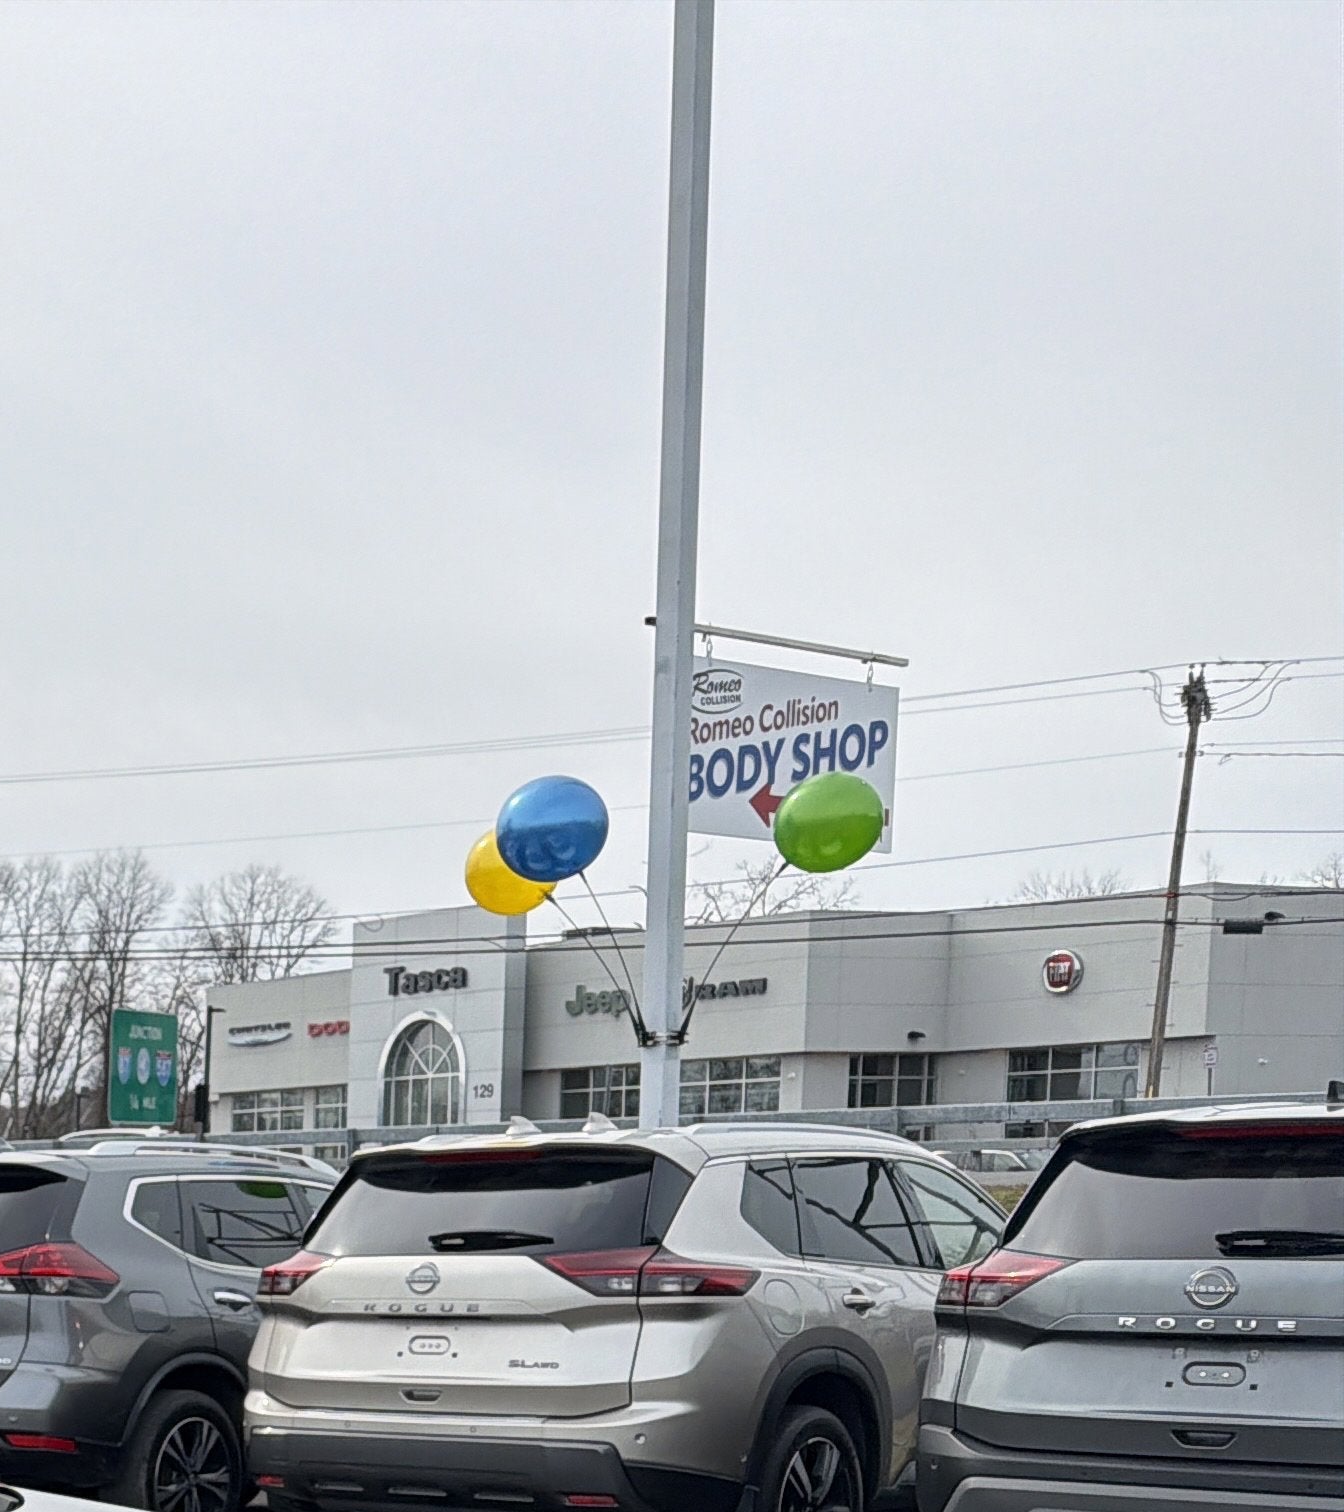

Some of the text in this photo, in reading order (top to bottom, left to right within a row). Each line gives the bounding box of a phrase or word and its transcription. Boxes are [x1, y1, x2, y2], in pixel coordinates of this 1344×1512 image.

[692, 671, 742, 698] Romeo
[700, 694, 742, 706] COLLISION
[759, 696, 839, 733] Collision
[791, 720, 889, 784] SHOP
[383, 966, 468, 996] Tasca
[694, 977, 768, 1001] RAM
[565, 984, 631, 1018] Jeep
[472, 1083, 495, 1099] 129
[1185, 1284, 1237, 1294] NISSAN
[363, 1303, 480, 1313] ROGUE
[1117, 1315, 1298, 1332] ROGUE
